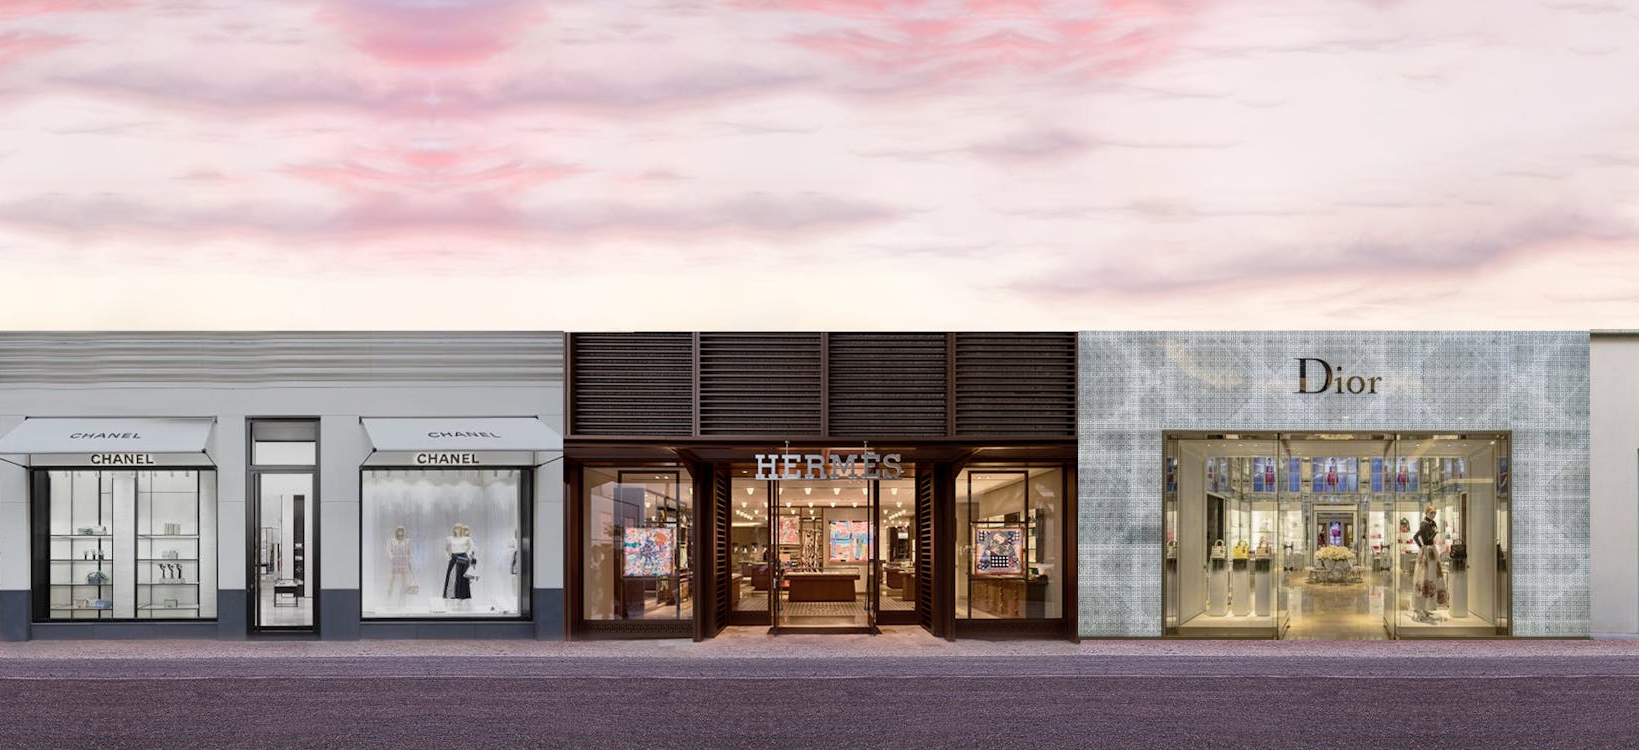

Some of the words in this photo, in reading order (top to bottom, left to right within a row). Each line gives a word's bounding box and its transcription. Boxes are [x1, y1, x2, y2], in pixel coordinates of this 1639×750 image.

[1293, 357, 1382, 394] Dior
[428, 431, 501, 439] CHANEL
[90, 454, 154, 464] CHANEL
[417, 453, 480, 464] CHANEL
[754, 451, 903, 480] HERMÈS
